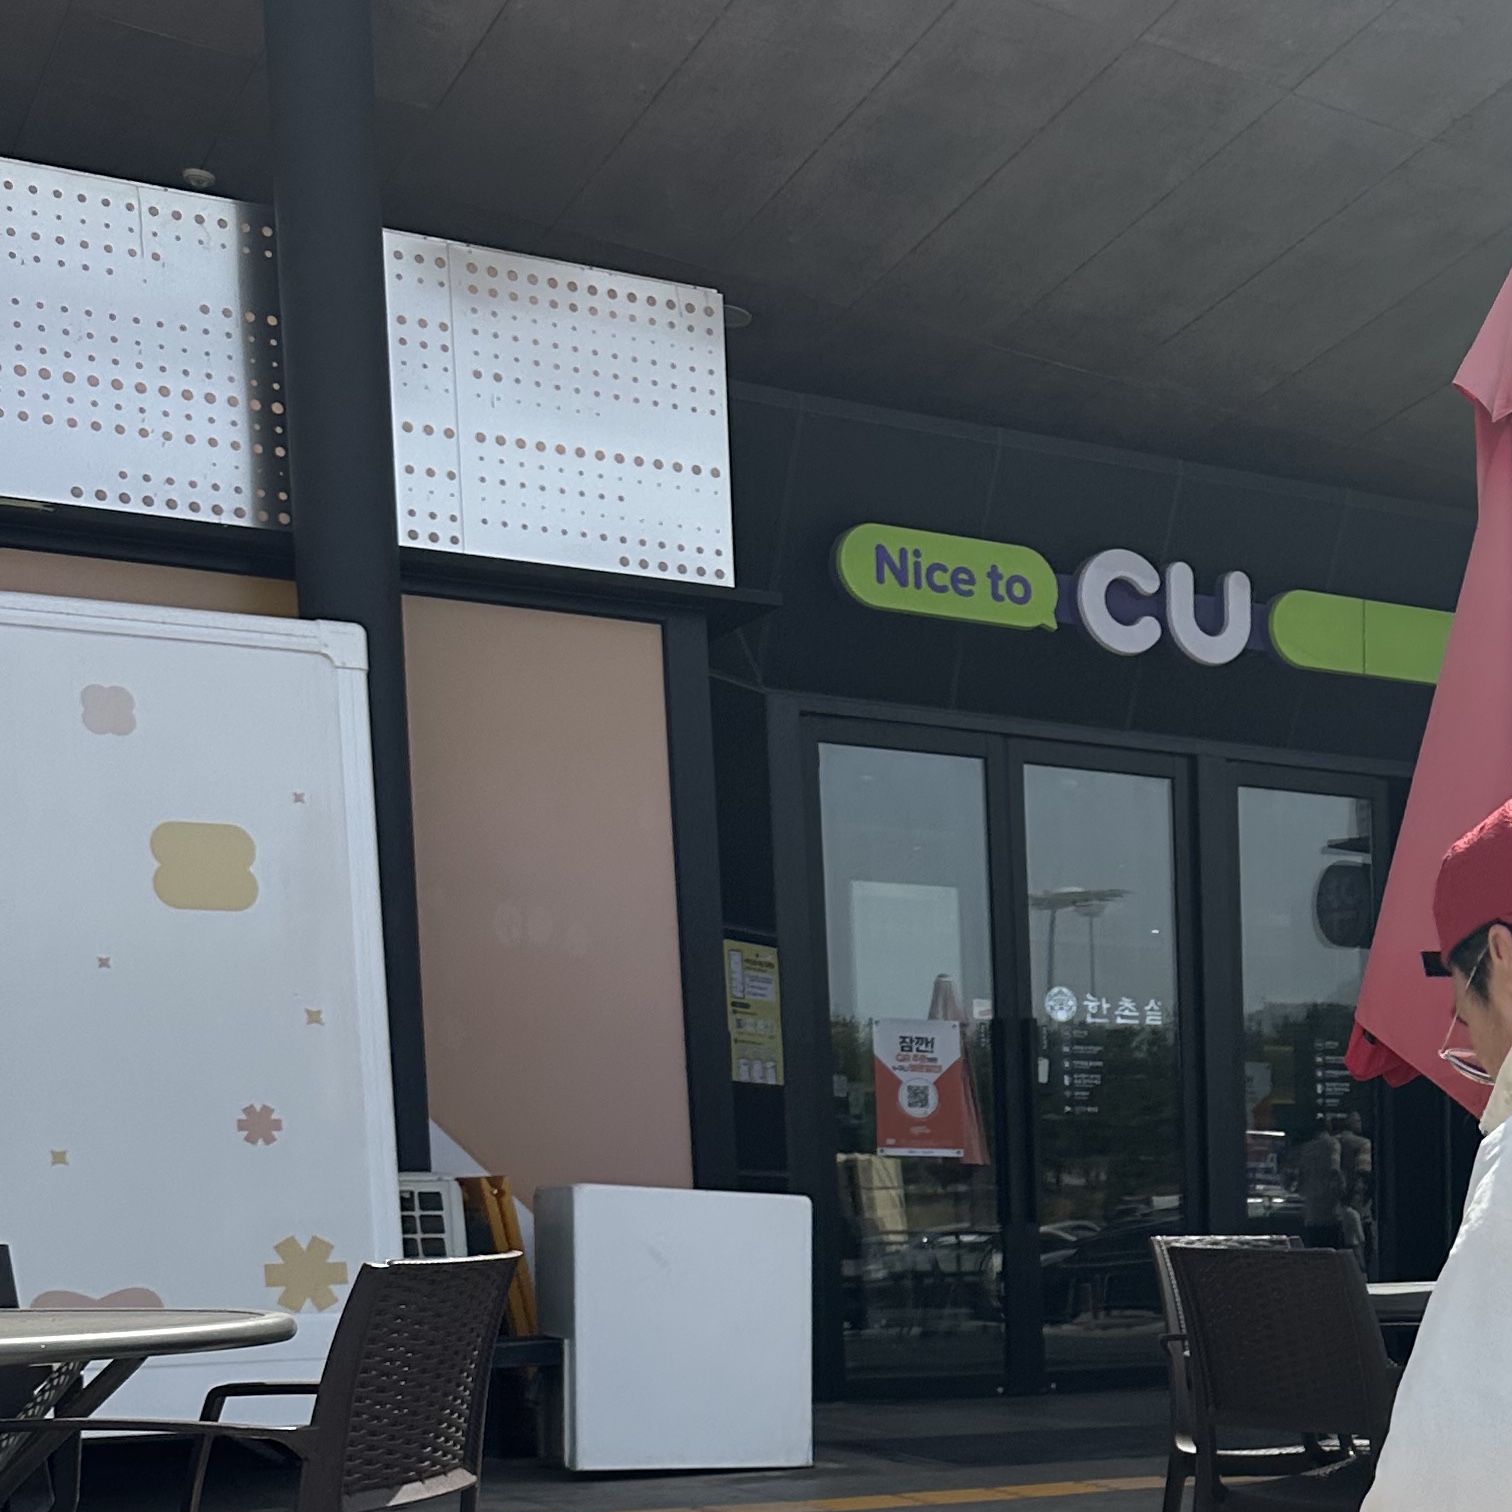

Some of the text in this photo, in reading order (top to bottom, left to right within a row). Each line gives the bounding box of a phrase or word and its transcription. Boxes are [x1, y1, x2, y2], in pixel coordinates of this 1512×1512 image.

[874, 543, 1033, 606] Nice to
[1077, 547, 1253, 666] CU
